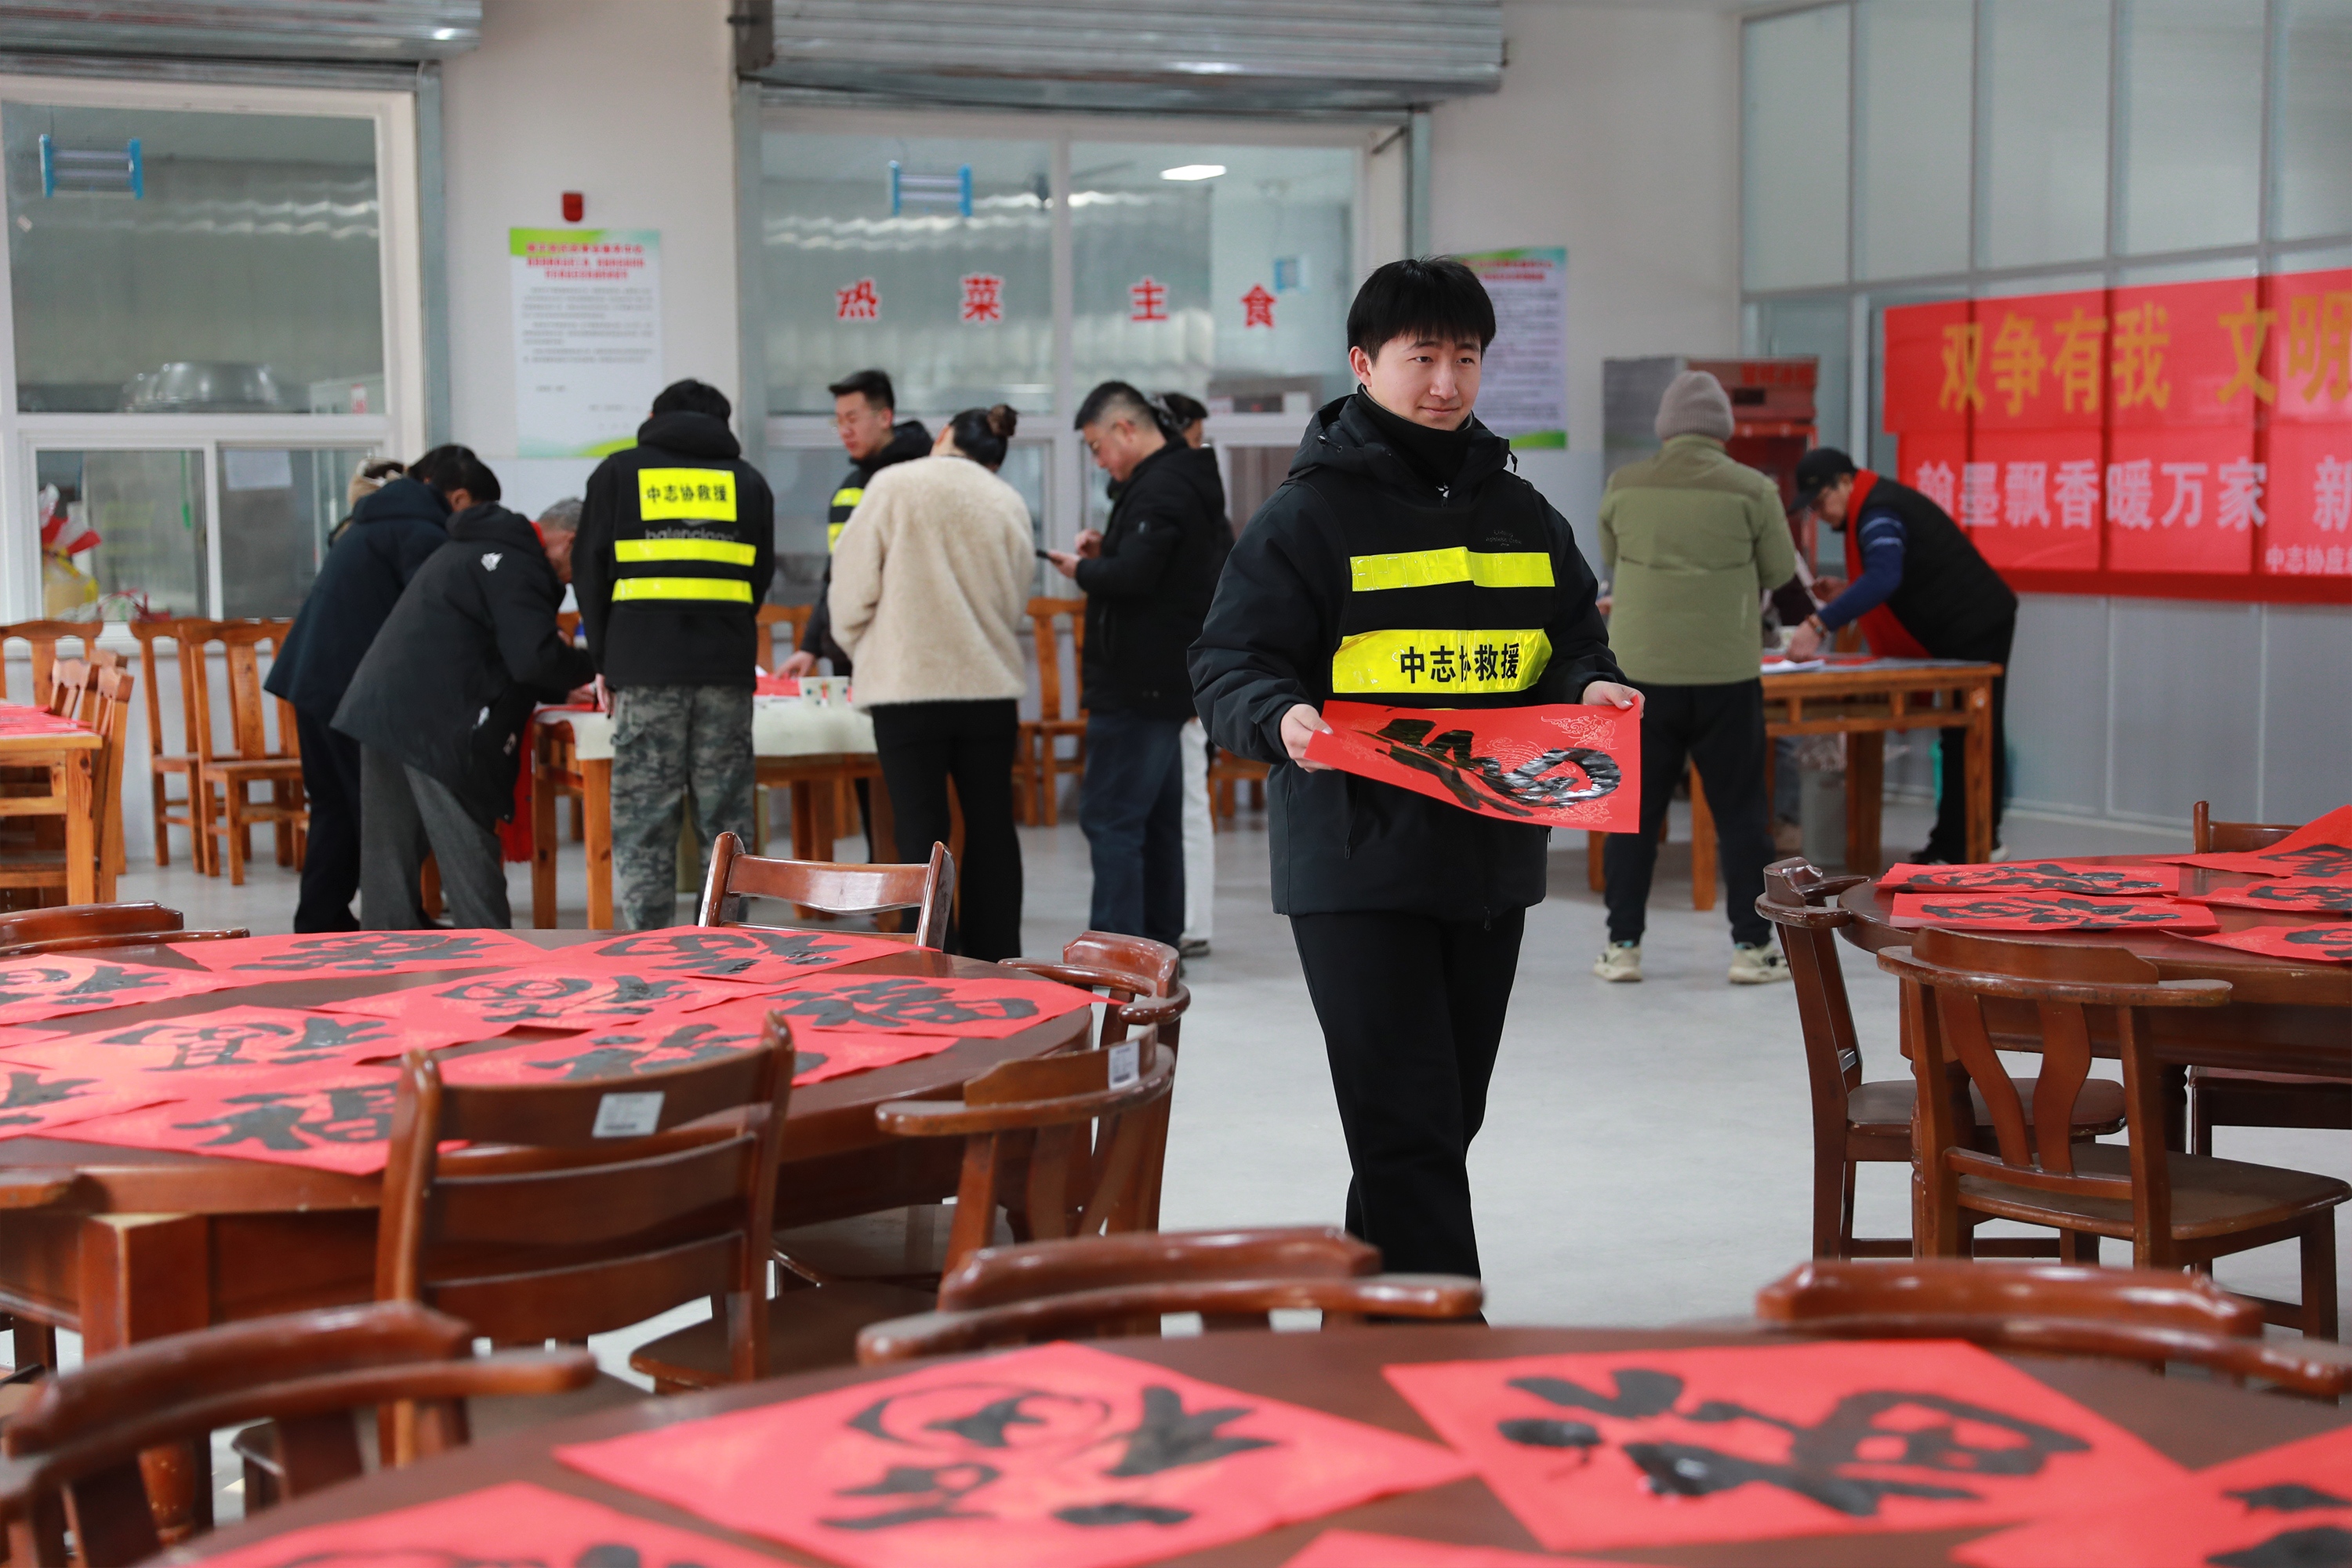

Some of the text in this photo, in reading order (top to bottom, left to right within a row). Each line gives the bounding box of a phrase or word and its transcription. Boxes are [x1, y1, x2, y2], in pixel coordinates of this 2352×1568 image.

[836, 276, 1276, 328] 热菜 主食
[1939, 291, 2352, 417] 双争有我 文明
[647, 485, 727, 503] 中志协救援
